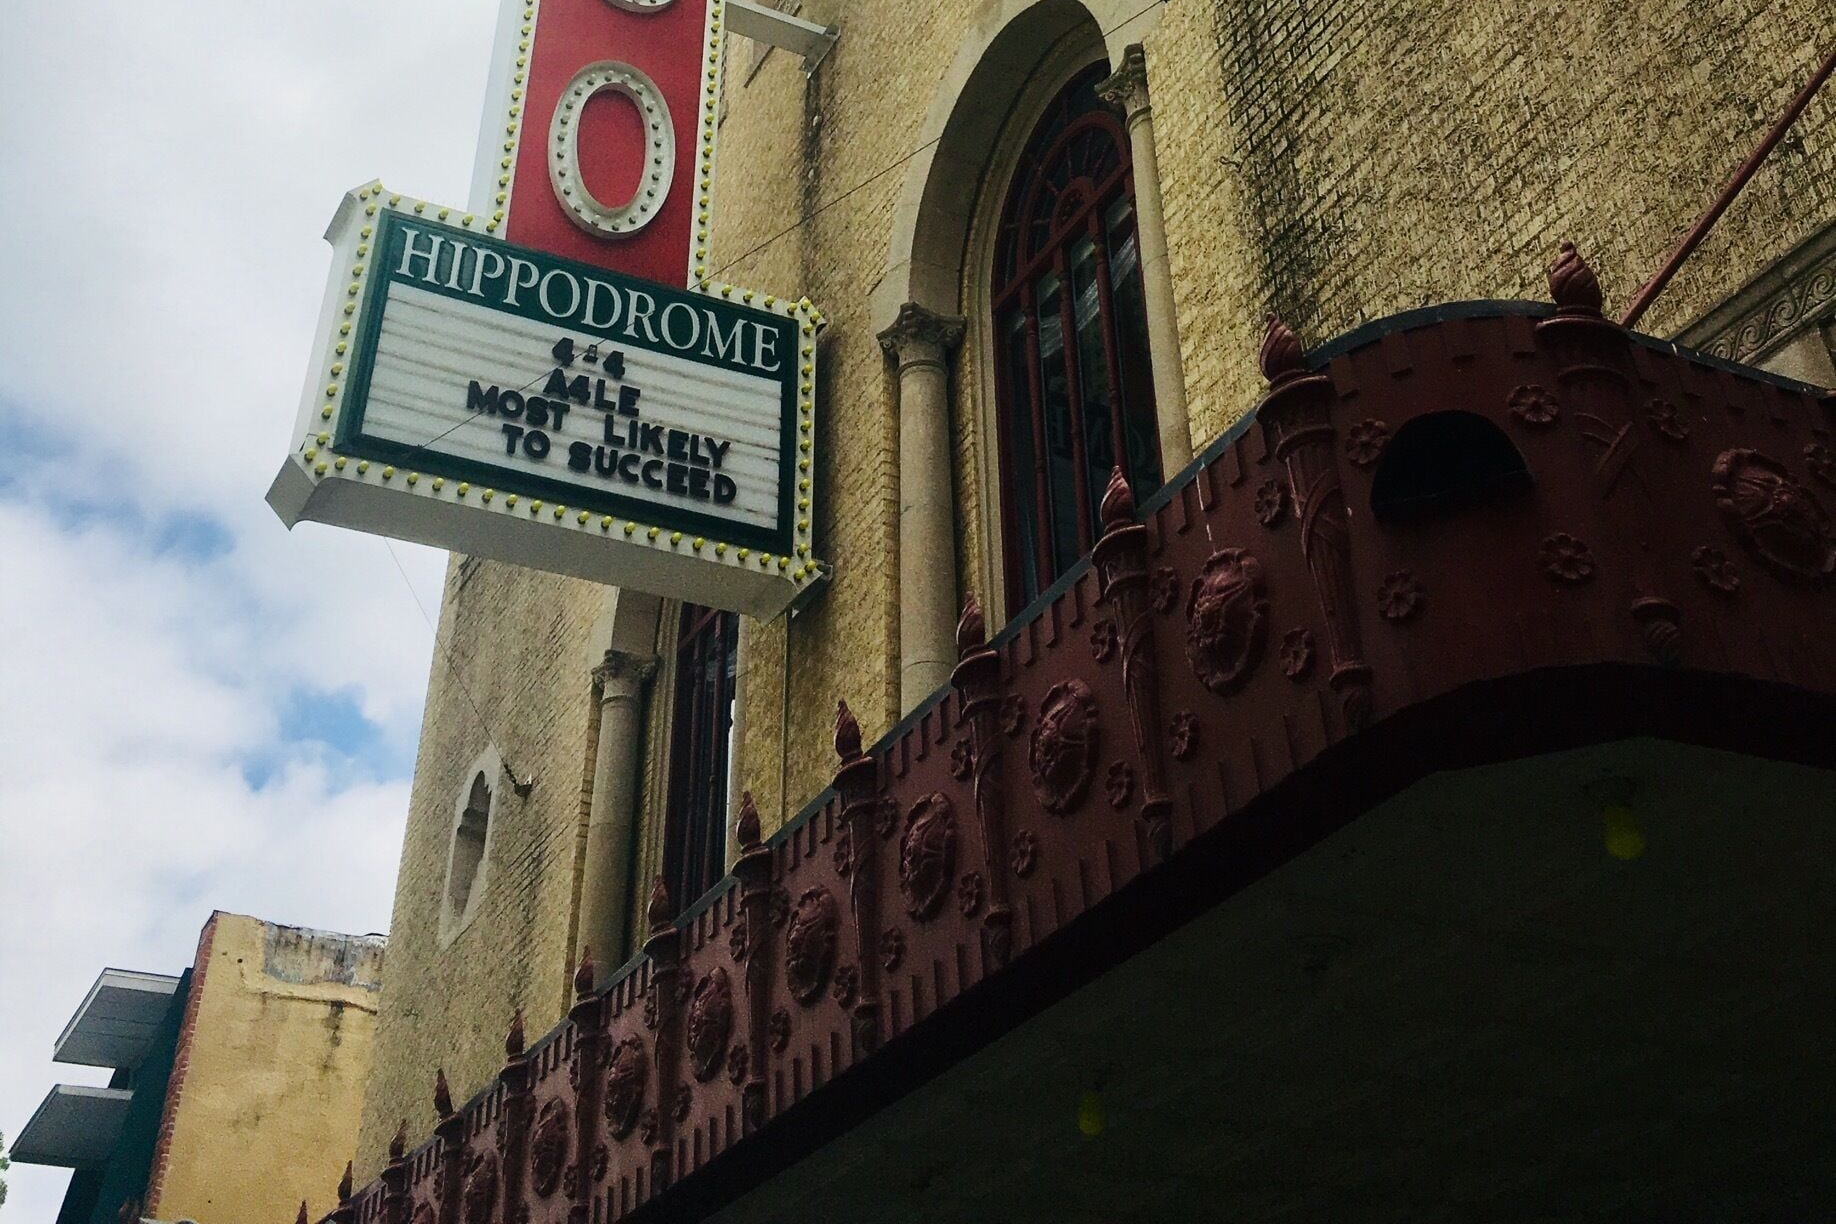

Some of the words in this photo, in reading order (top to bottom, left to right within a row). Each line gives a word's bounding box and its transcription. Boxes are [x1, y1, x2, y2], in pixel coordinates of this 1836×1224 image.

[395, 226, 783, 373] HIPPODROME
[466, 379, 571, 431] MOST
[603, 414, 731, 468] LIKELY
[542, 367, 641, 417] A4LE
[502, 423, 551, 459] TO
[567, 440, 738, 504] SUCCEED
